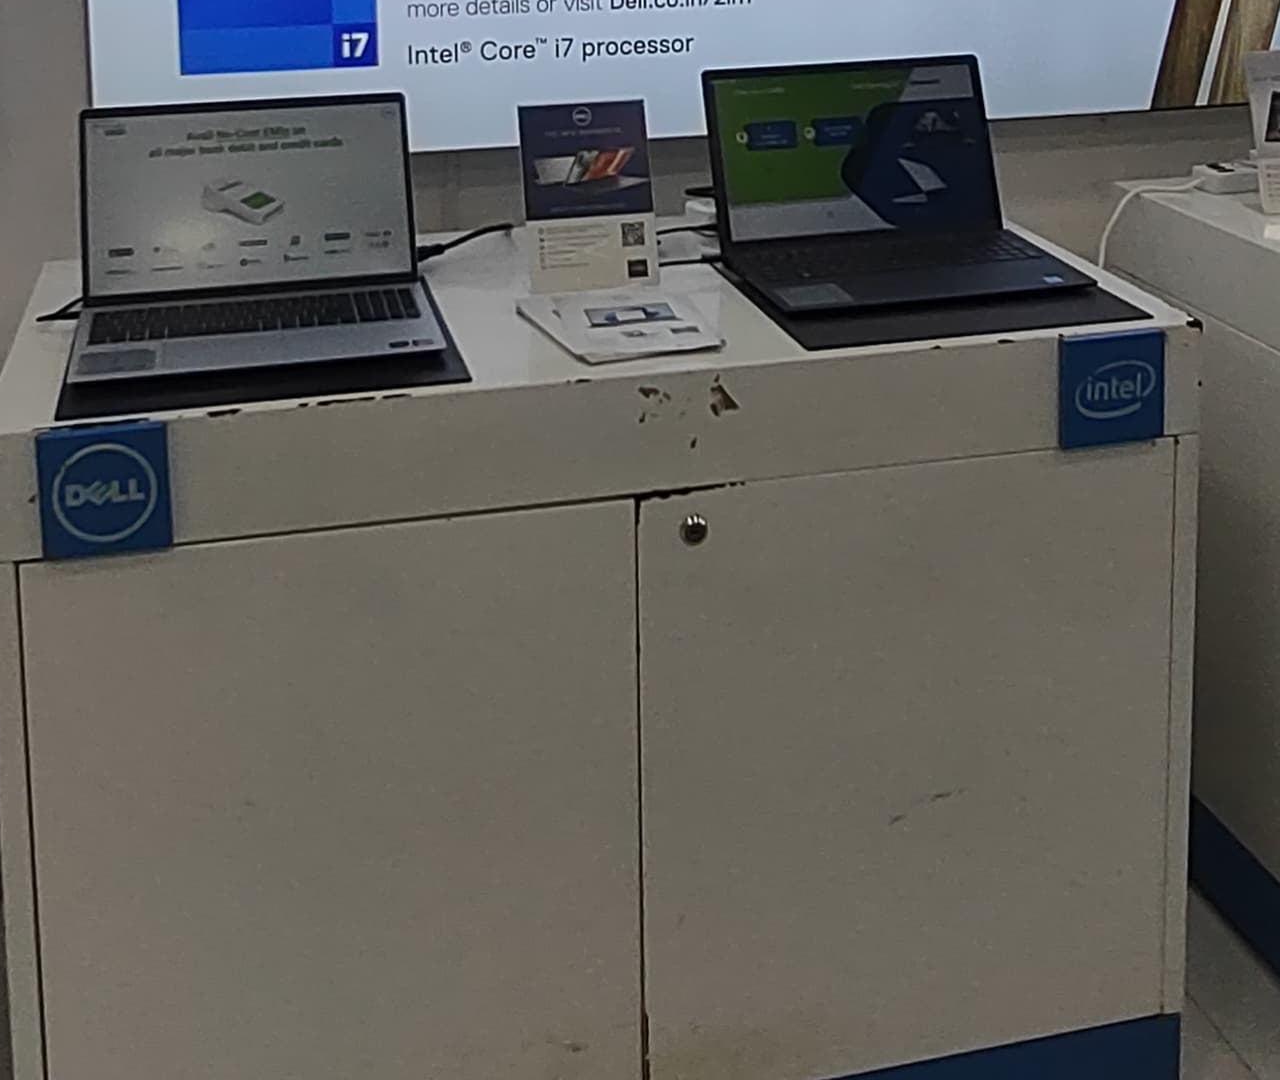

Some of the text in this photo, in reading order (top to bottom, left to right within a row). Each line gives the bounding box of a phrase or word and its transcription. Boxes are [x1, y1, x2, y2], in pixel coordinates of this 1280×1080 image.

[408, 0, 460, 19] more
[536, 0, 558, 13] or
[341, 32, 369, 58] i7
[554, 38, 574, 58] i7
[582, 36, 694, 62] processor
[1086, 371, 1141, 401] intel
[65, 478, 145, 507] DELL
